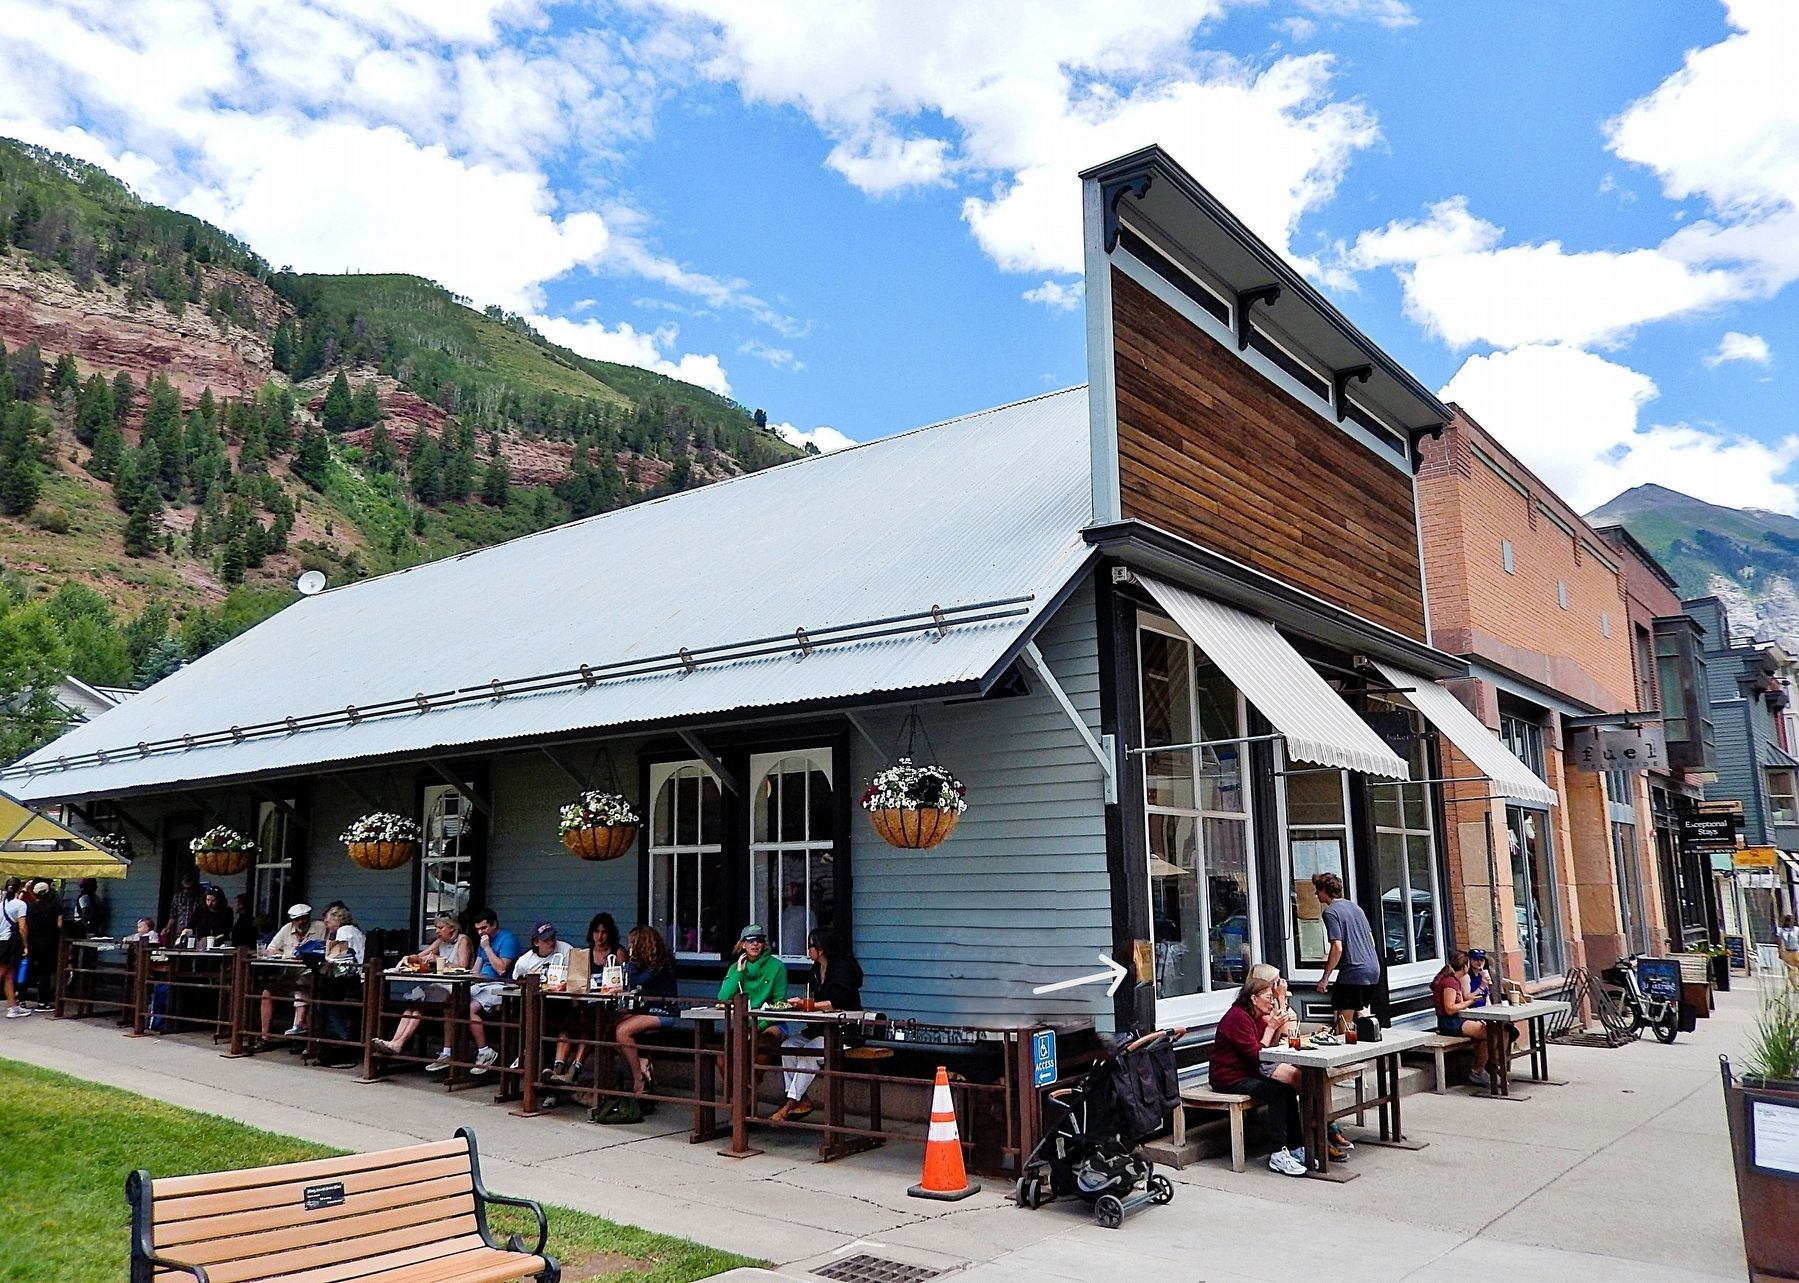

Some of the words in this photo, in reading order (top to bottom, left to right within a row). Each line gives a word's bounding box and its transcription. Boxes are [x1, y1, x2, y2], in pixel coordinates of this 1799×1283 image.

[1582, 743, 1657, 761] fuel
[1685, 820, 1728, 829] Exceptional
[1698, 828, 1718, 836] Stays
[1036, 1060, 1054, 1072] ACCESS
